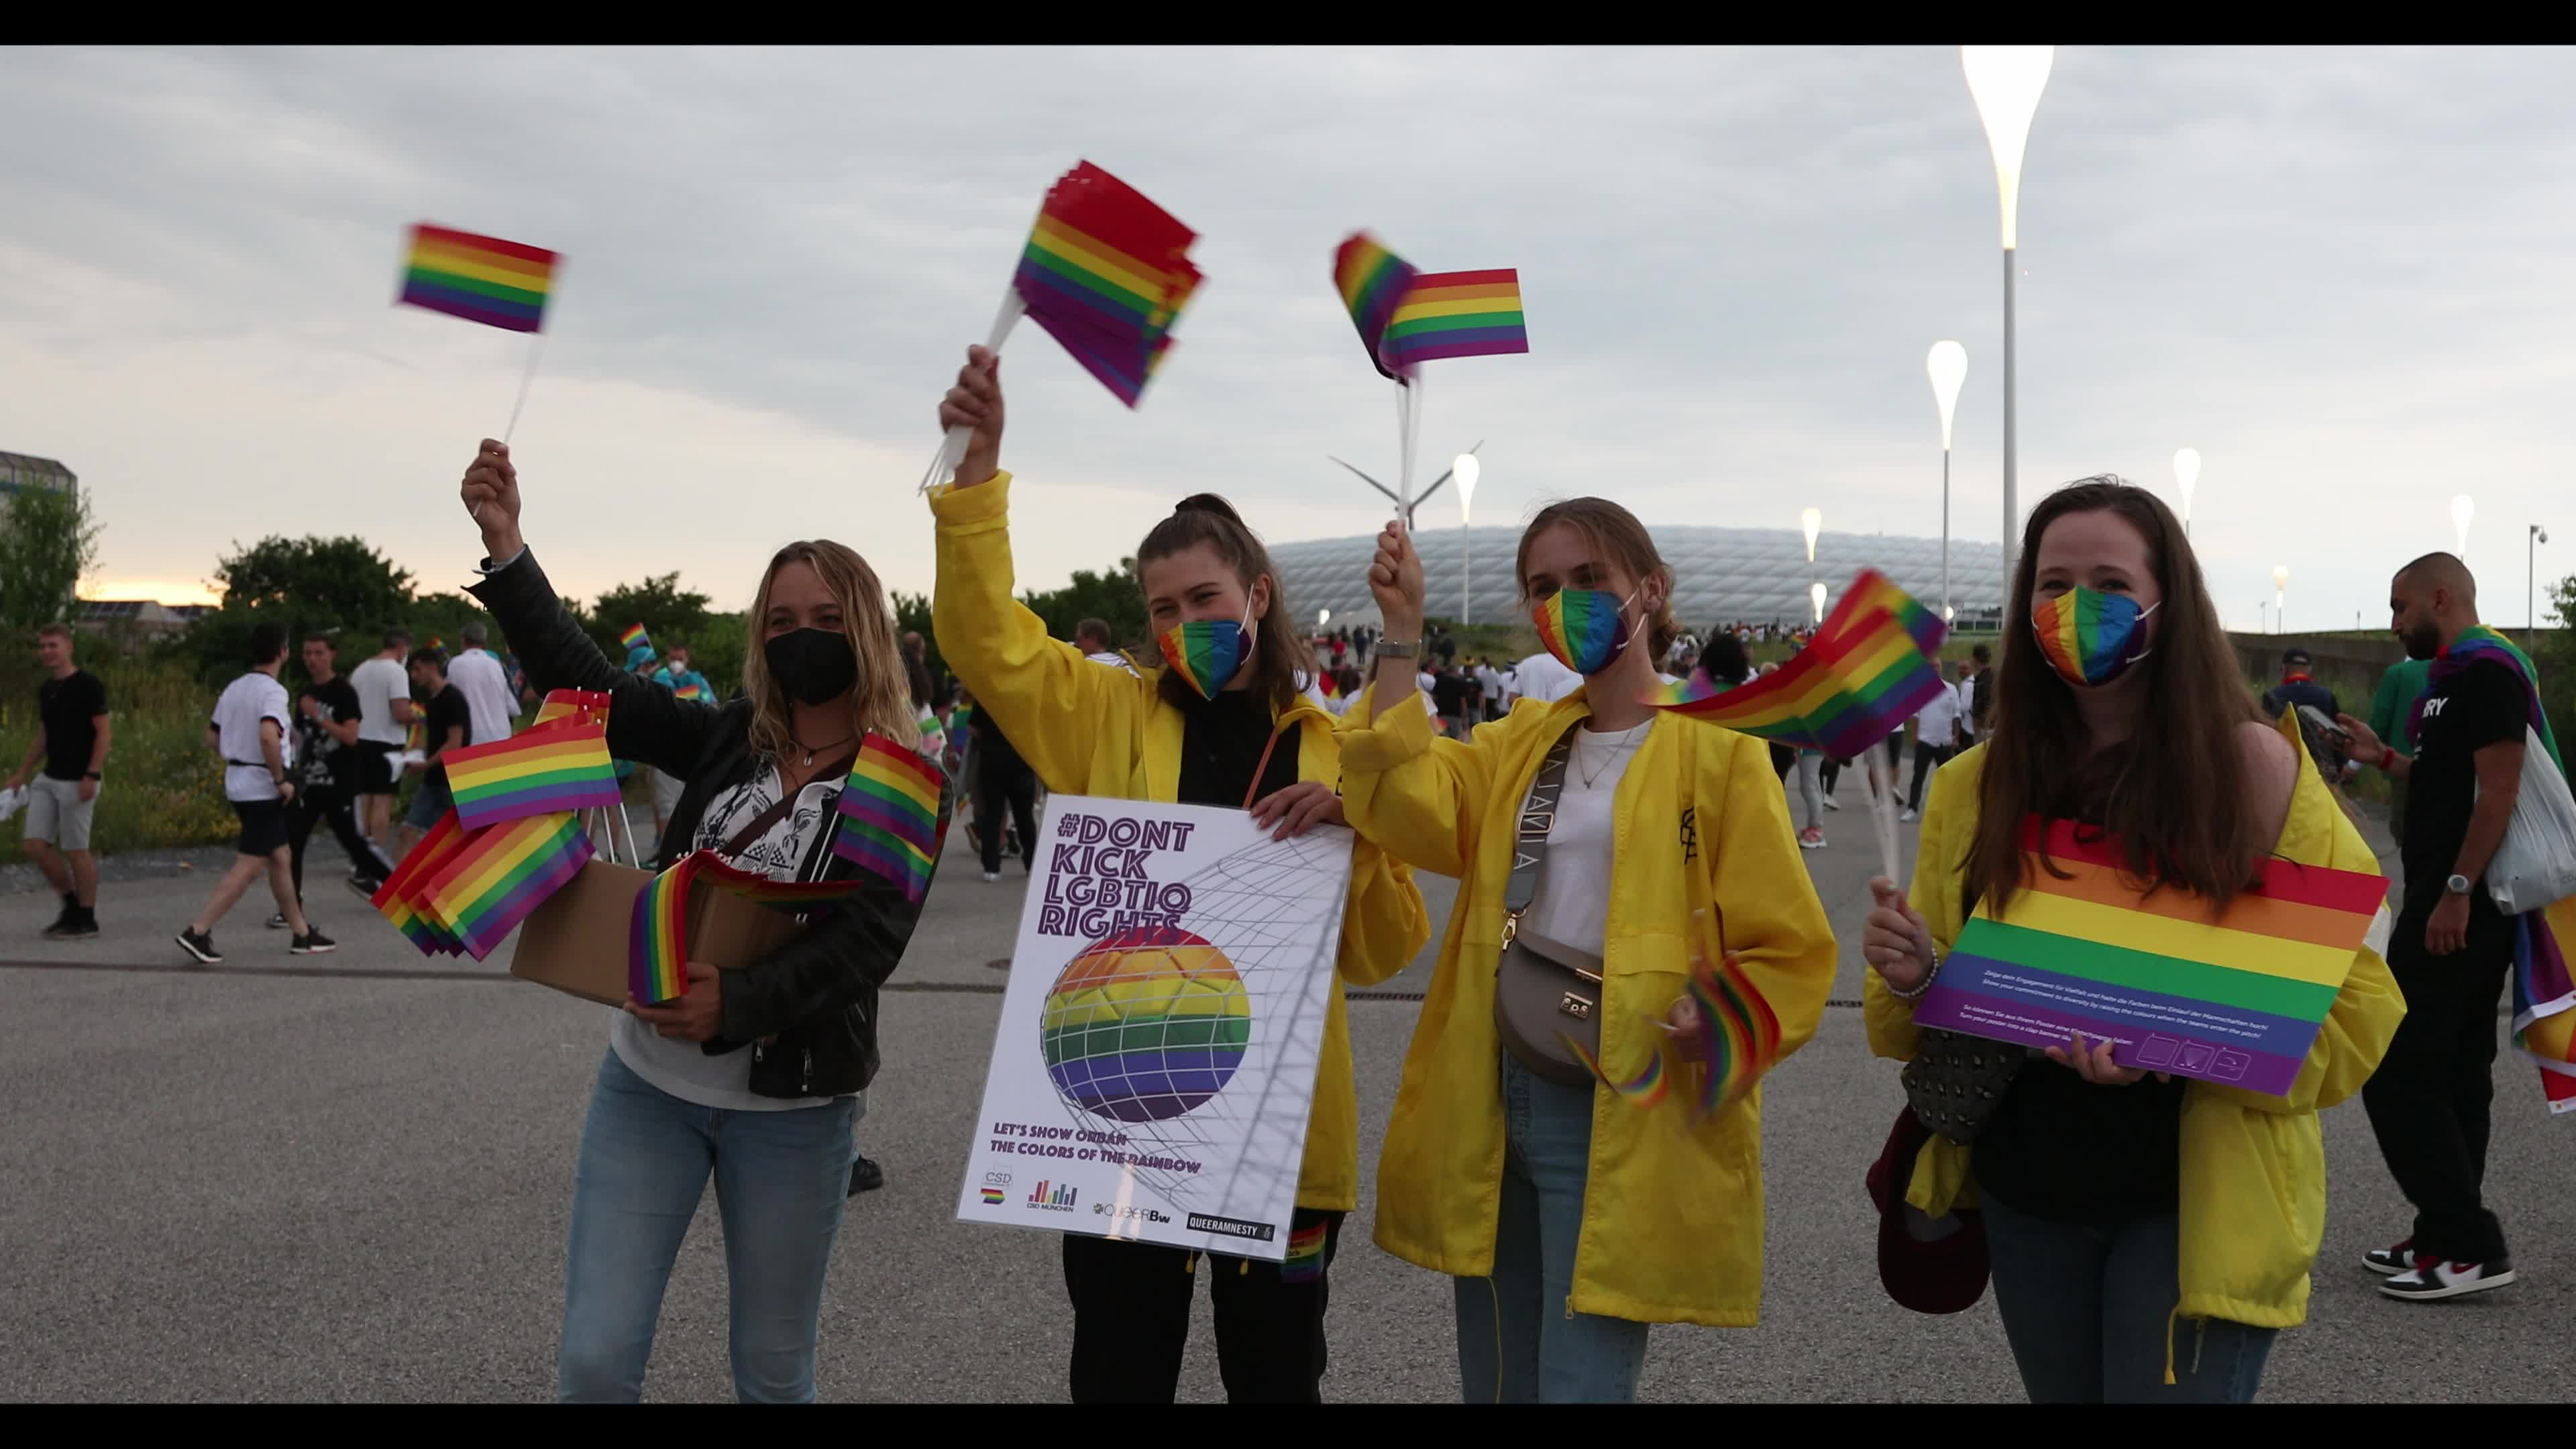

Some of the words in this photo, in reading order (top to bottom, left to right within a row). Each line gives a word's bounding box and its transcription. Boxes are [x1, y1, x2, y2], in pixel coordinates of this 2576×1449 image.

[1057, 813, 1195, 852] #DONT
[1050, 843, 1153, 879] KICK
[1044, 873, 1192, 914] LGBTIQ
[1038, 905, 1181, 945] RIGHTS
[2015, 986, 2055, 998] commitment
[2063, 996, 2090, 1006] diversity
[2016, 977, 2055, 989] Engagement
[2128, 1000, 2150, 1008] Farben
[2202, 1013, 2249, 1026] Mannschaften
[994, 1122, 1027, 1136] LET'S
[1029, 1126, 1073, 1140] SHOW
[990, 1140, 1015, 1153] THE
[1018, 1142, 1074, 1159] COLORS
[1077, 1148, 1097, 1161] OF
[1100, 1150, 1126, 1164] THE
[1128, 1153, 1201, 1174] RAINBOW
[986, 1172, 1012, 1183] CSD
[1189, 1217, 1258, 1236] QUEERAMNESTY
